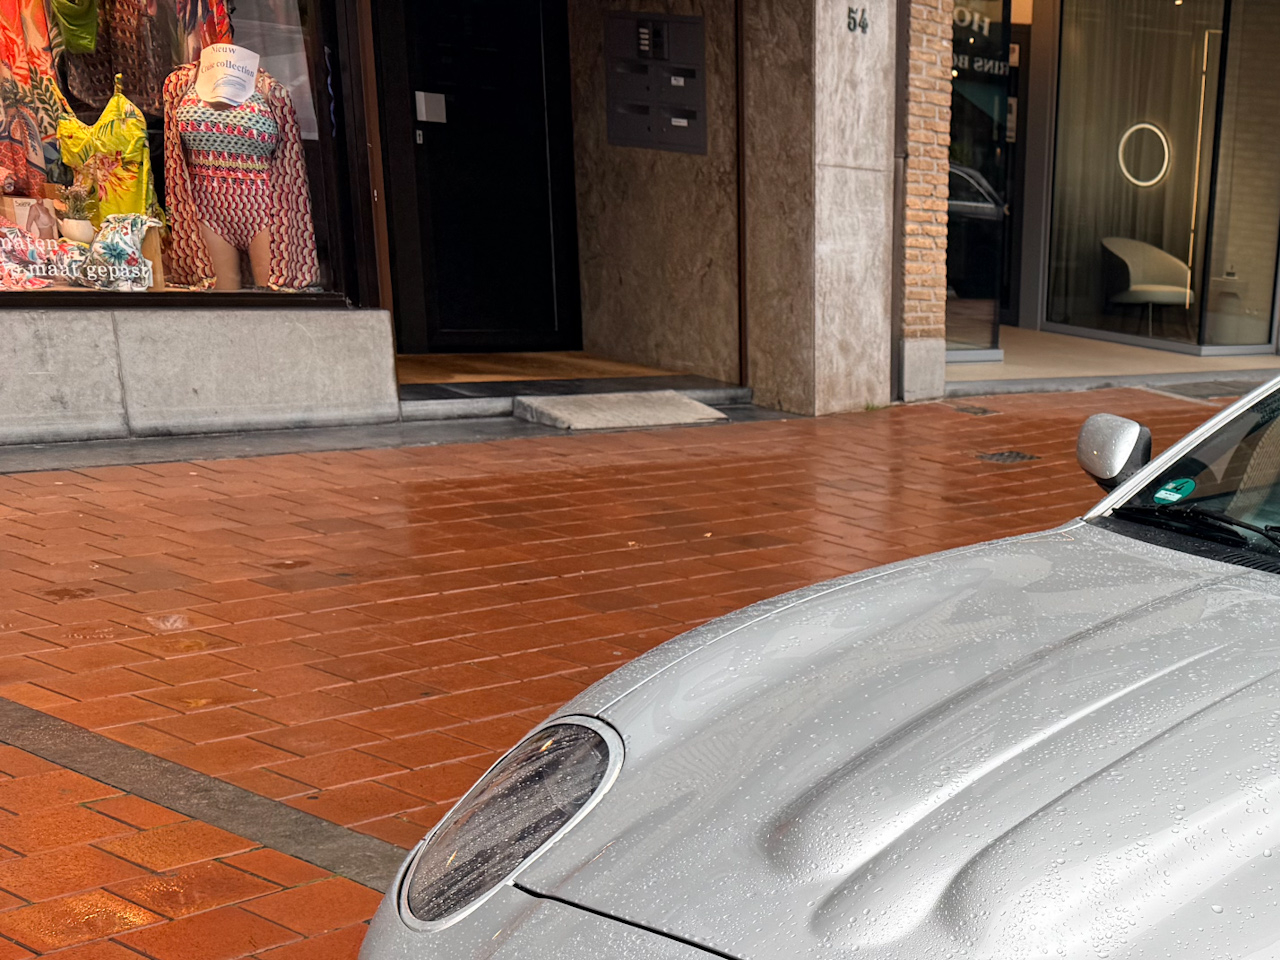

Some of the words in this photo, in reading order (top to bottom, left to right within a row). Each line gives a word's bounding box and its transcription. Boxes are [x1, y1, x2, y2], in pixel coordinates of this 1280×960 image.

[847, 7, 868, 34] 54
[216, 60, 255, 77] collection
[30, 263, 80, 277] maat
[87, 264, 149, 280] gepast
